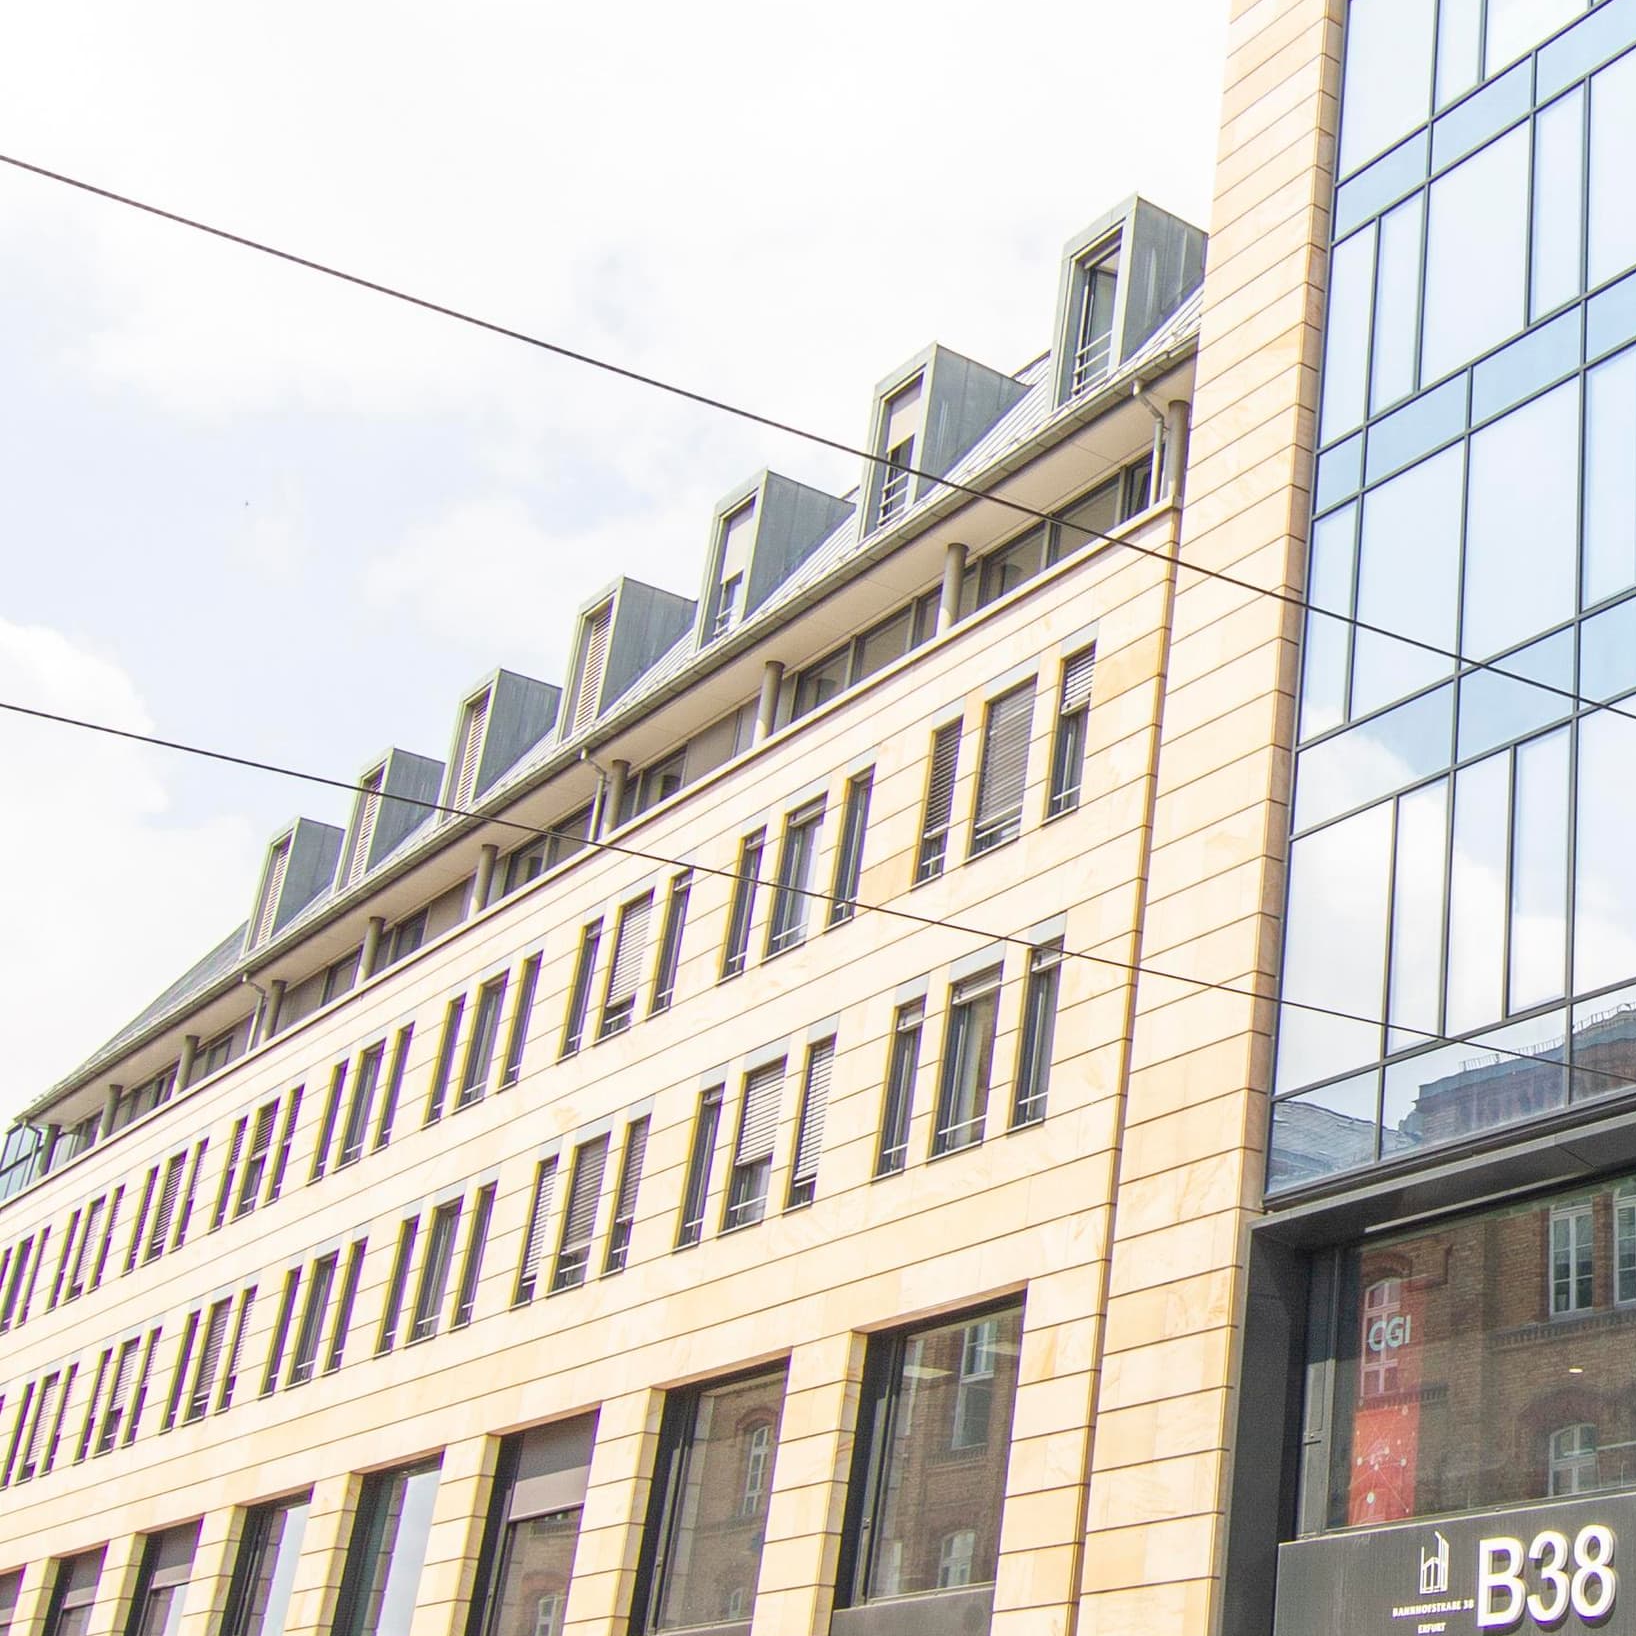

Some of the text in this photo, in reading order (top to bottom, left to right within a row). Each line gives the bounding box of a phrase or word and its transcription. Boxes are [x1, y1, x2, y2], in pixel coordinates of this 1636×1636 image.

[1368, 1315, 1411, 1351] CGI
[1477, 1524, 1617, 1627] B38
[1417, 1622, 1447, 1634] ERFURT
